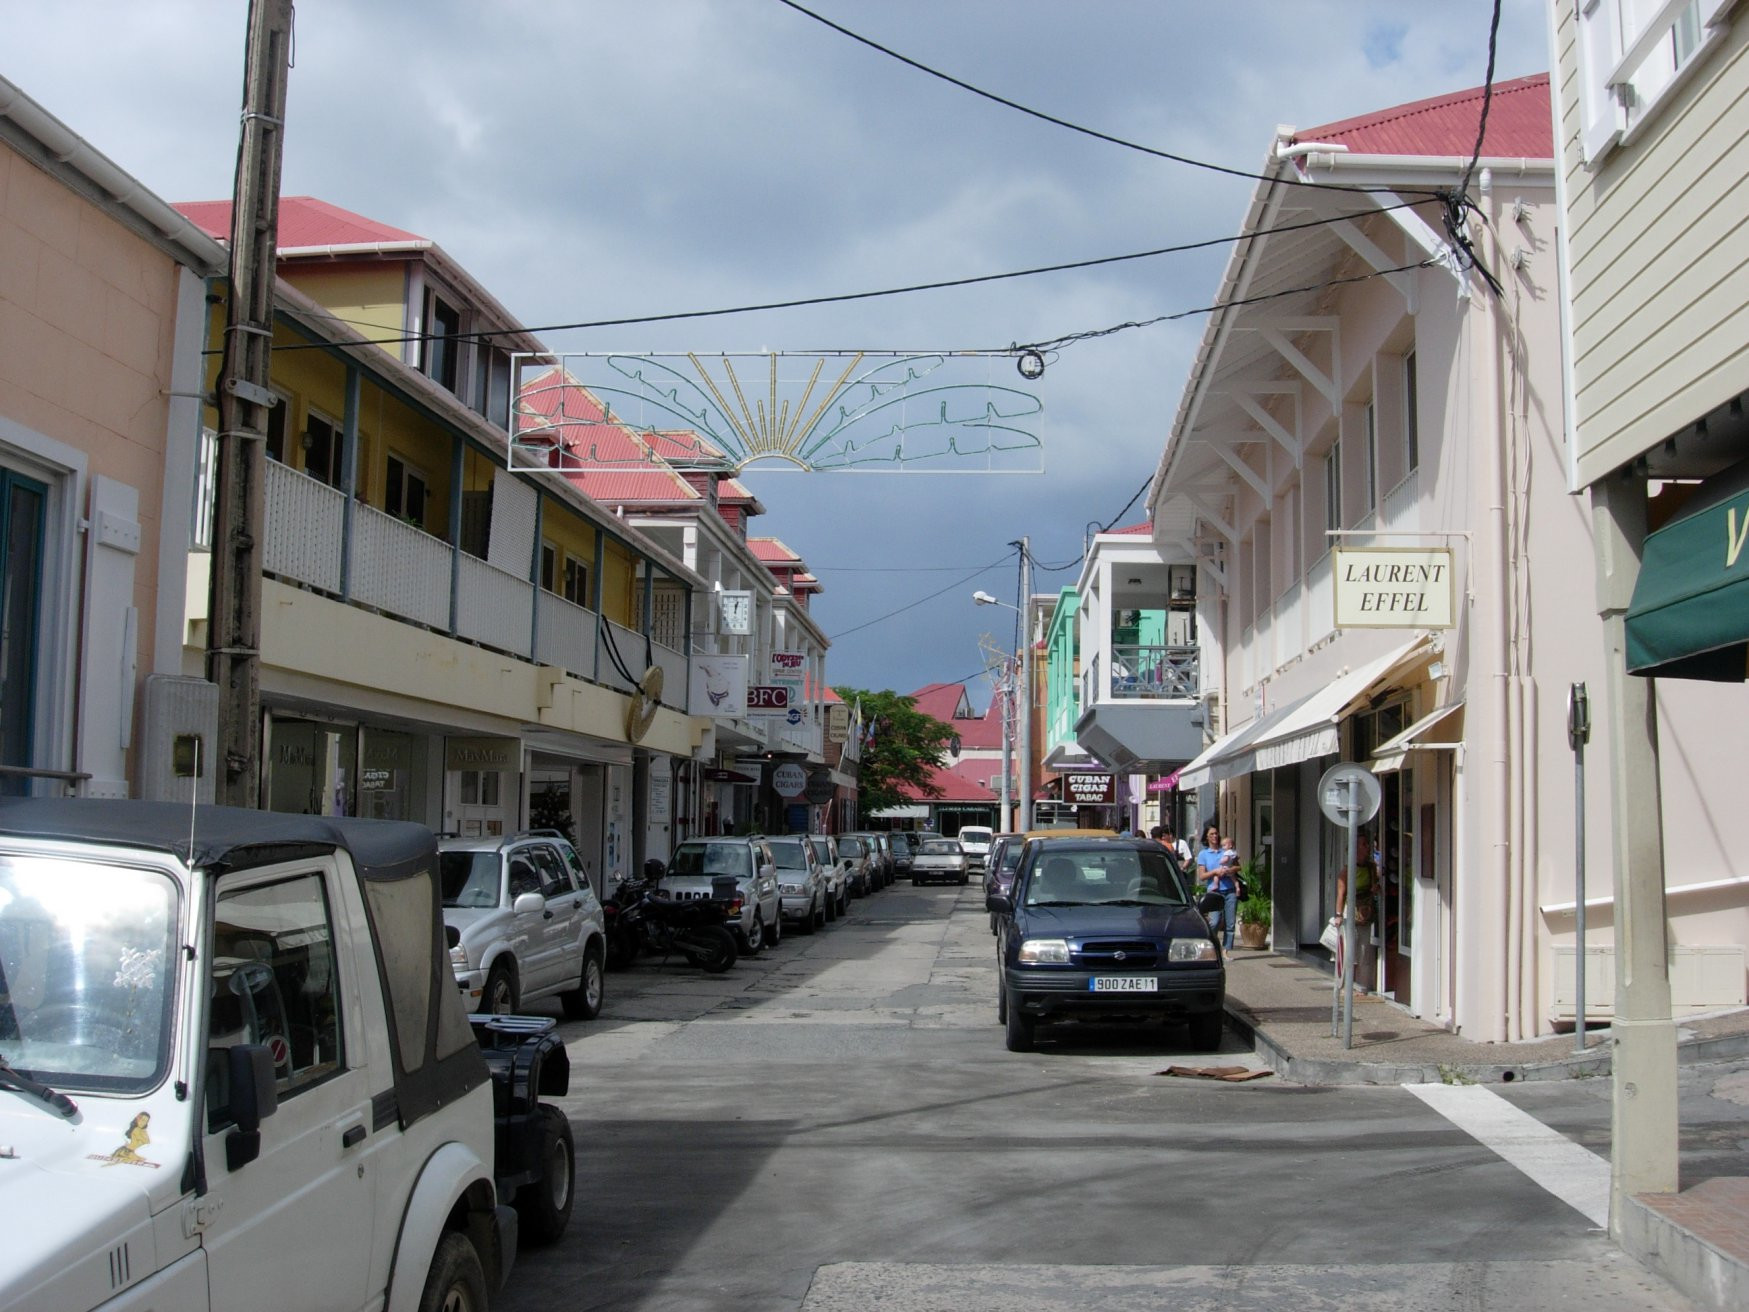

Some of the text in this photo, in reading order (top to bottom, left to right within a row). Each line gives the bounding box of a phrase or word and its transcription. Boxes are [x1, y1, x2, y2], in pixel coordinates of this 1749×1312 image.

[1346, 564, 1446, 583] LAURENT
[1360, 592, 1429, 612] EFFEL
[747, 689, 787, 706] BFC
[776, 771, 803, 779] CUBAN
[1069, 775, 1110, 784] CUBAN
[775, 781, 804, 789] CIGARS
[1070, 784, 1108, 792] CIGAR
[1075, 793, 1103, 802] TABAC
